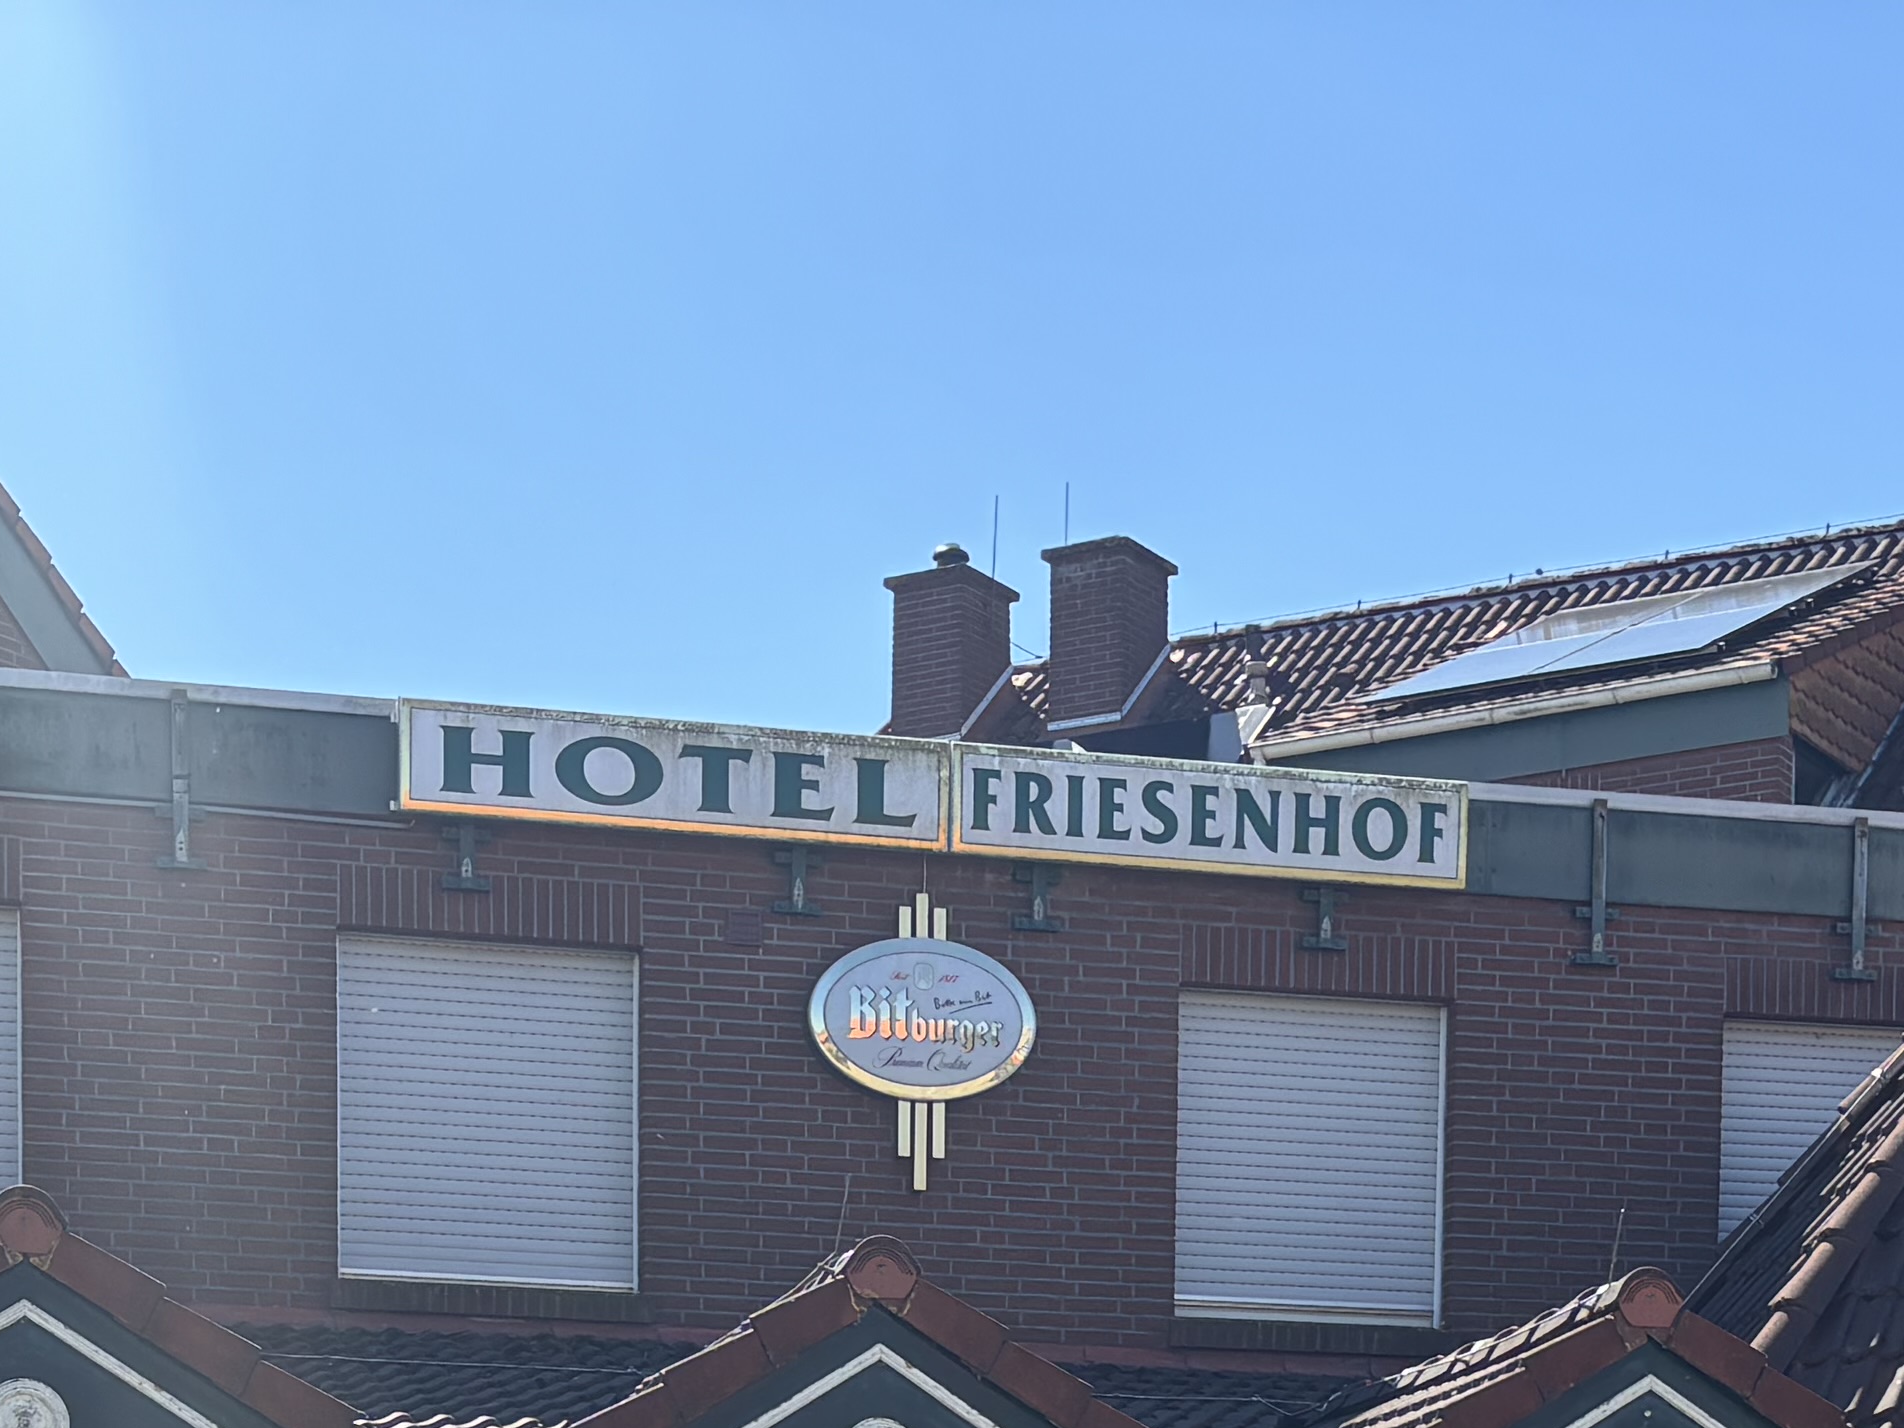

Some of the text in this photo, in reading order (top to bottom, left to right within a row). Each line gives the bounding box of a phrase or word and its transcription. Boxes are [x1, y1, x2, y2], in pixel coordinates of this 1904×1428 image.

[439, 724, 1448, 864] HOTEL FRIESENHOF
[847, 984, 1004, 1053] Bitburger
